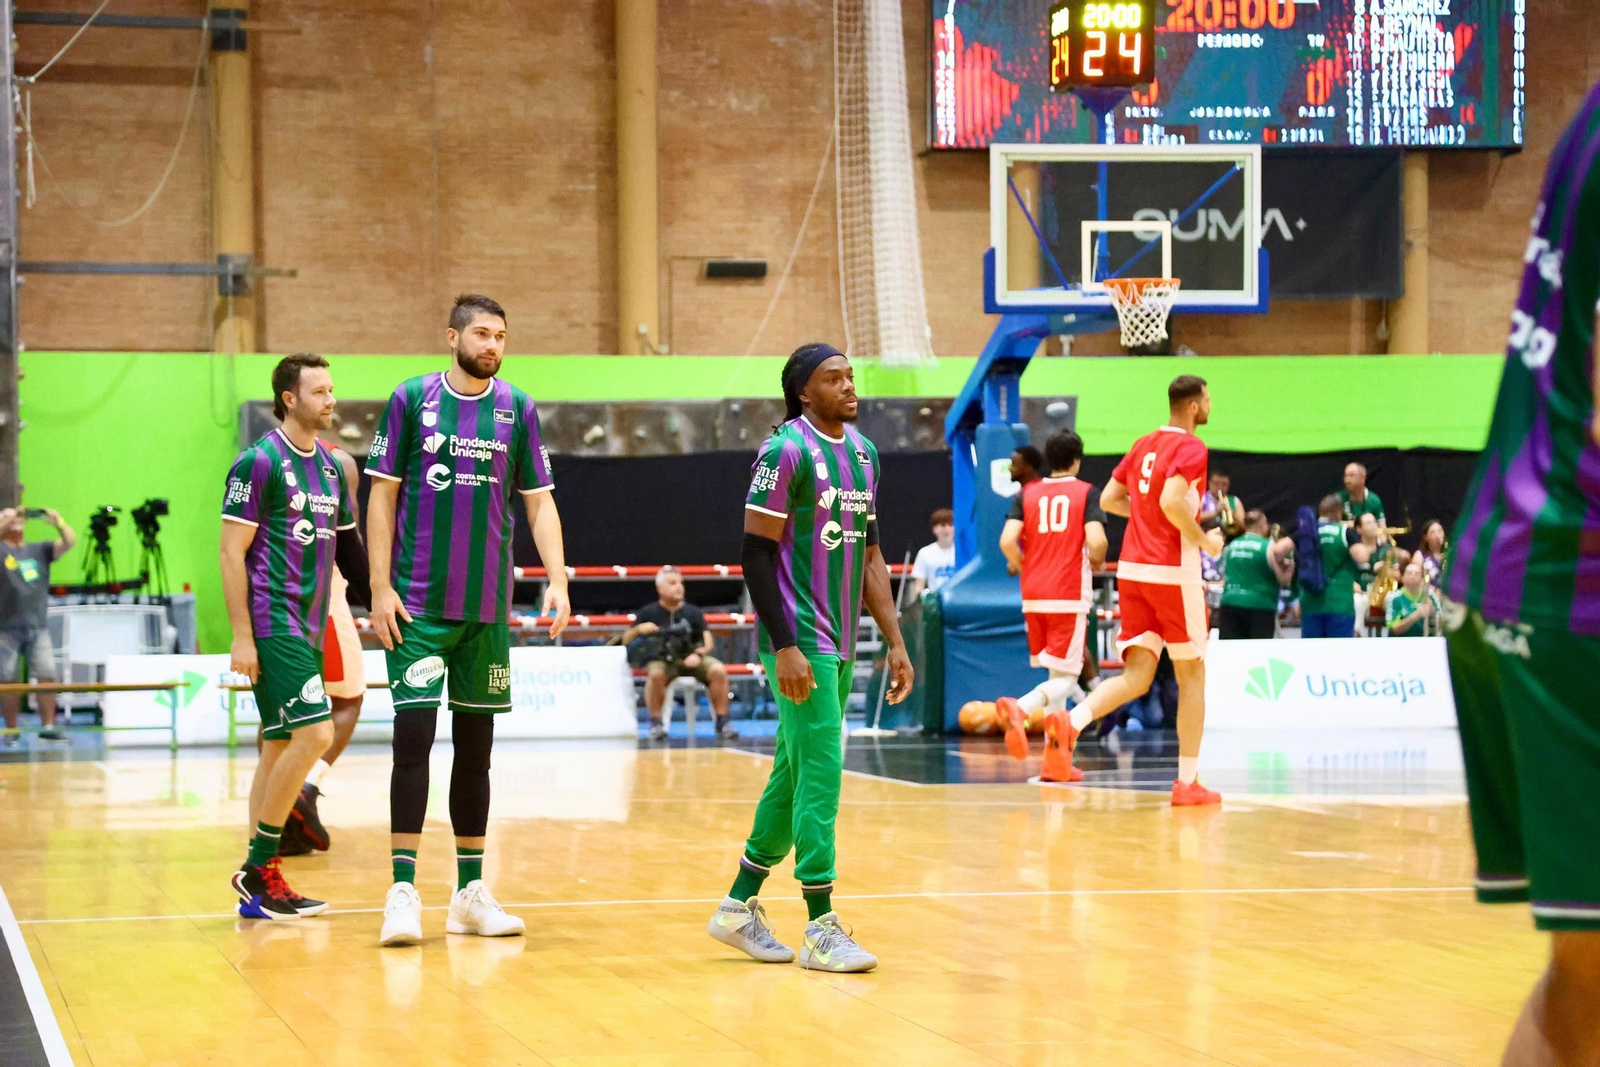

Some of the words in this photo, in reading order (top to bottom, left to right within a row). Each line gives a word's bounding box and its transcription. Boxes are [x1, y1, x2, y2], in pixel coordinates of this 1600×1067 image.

[1084, 3, 1141, 28] 20:00
[1051, 35, 1069, 85] 24
[1083, 31, 1142, 76] 24
[449, 434, 508, 453] Fundación
[449, 445, 493, 462] Unicaja
[455, 472, 476, 481] COSTA
[476, 474, 488, 482] DEL
[1138, 452, 1156, 495] 9
[1037, 494, 1070, 534] 10
[1305, 672, 1426, 703] Unicaja
